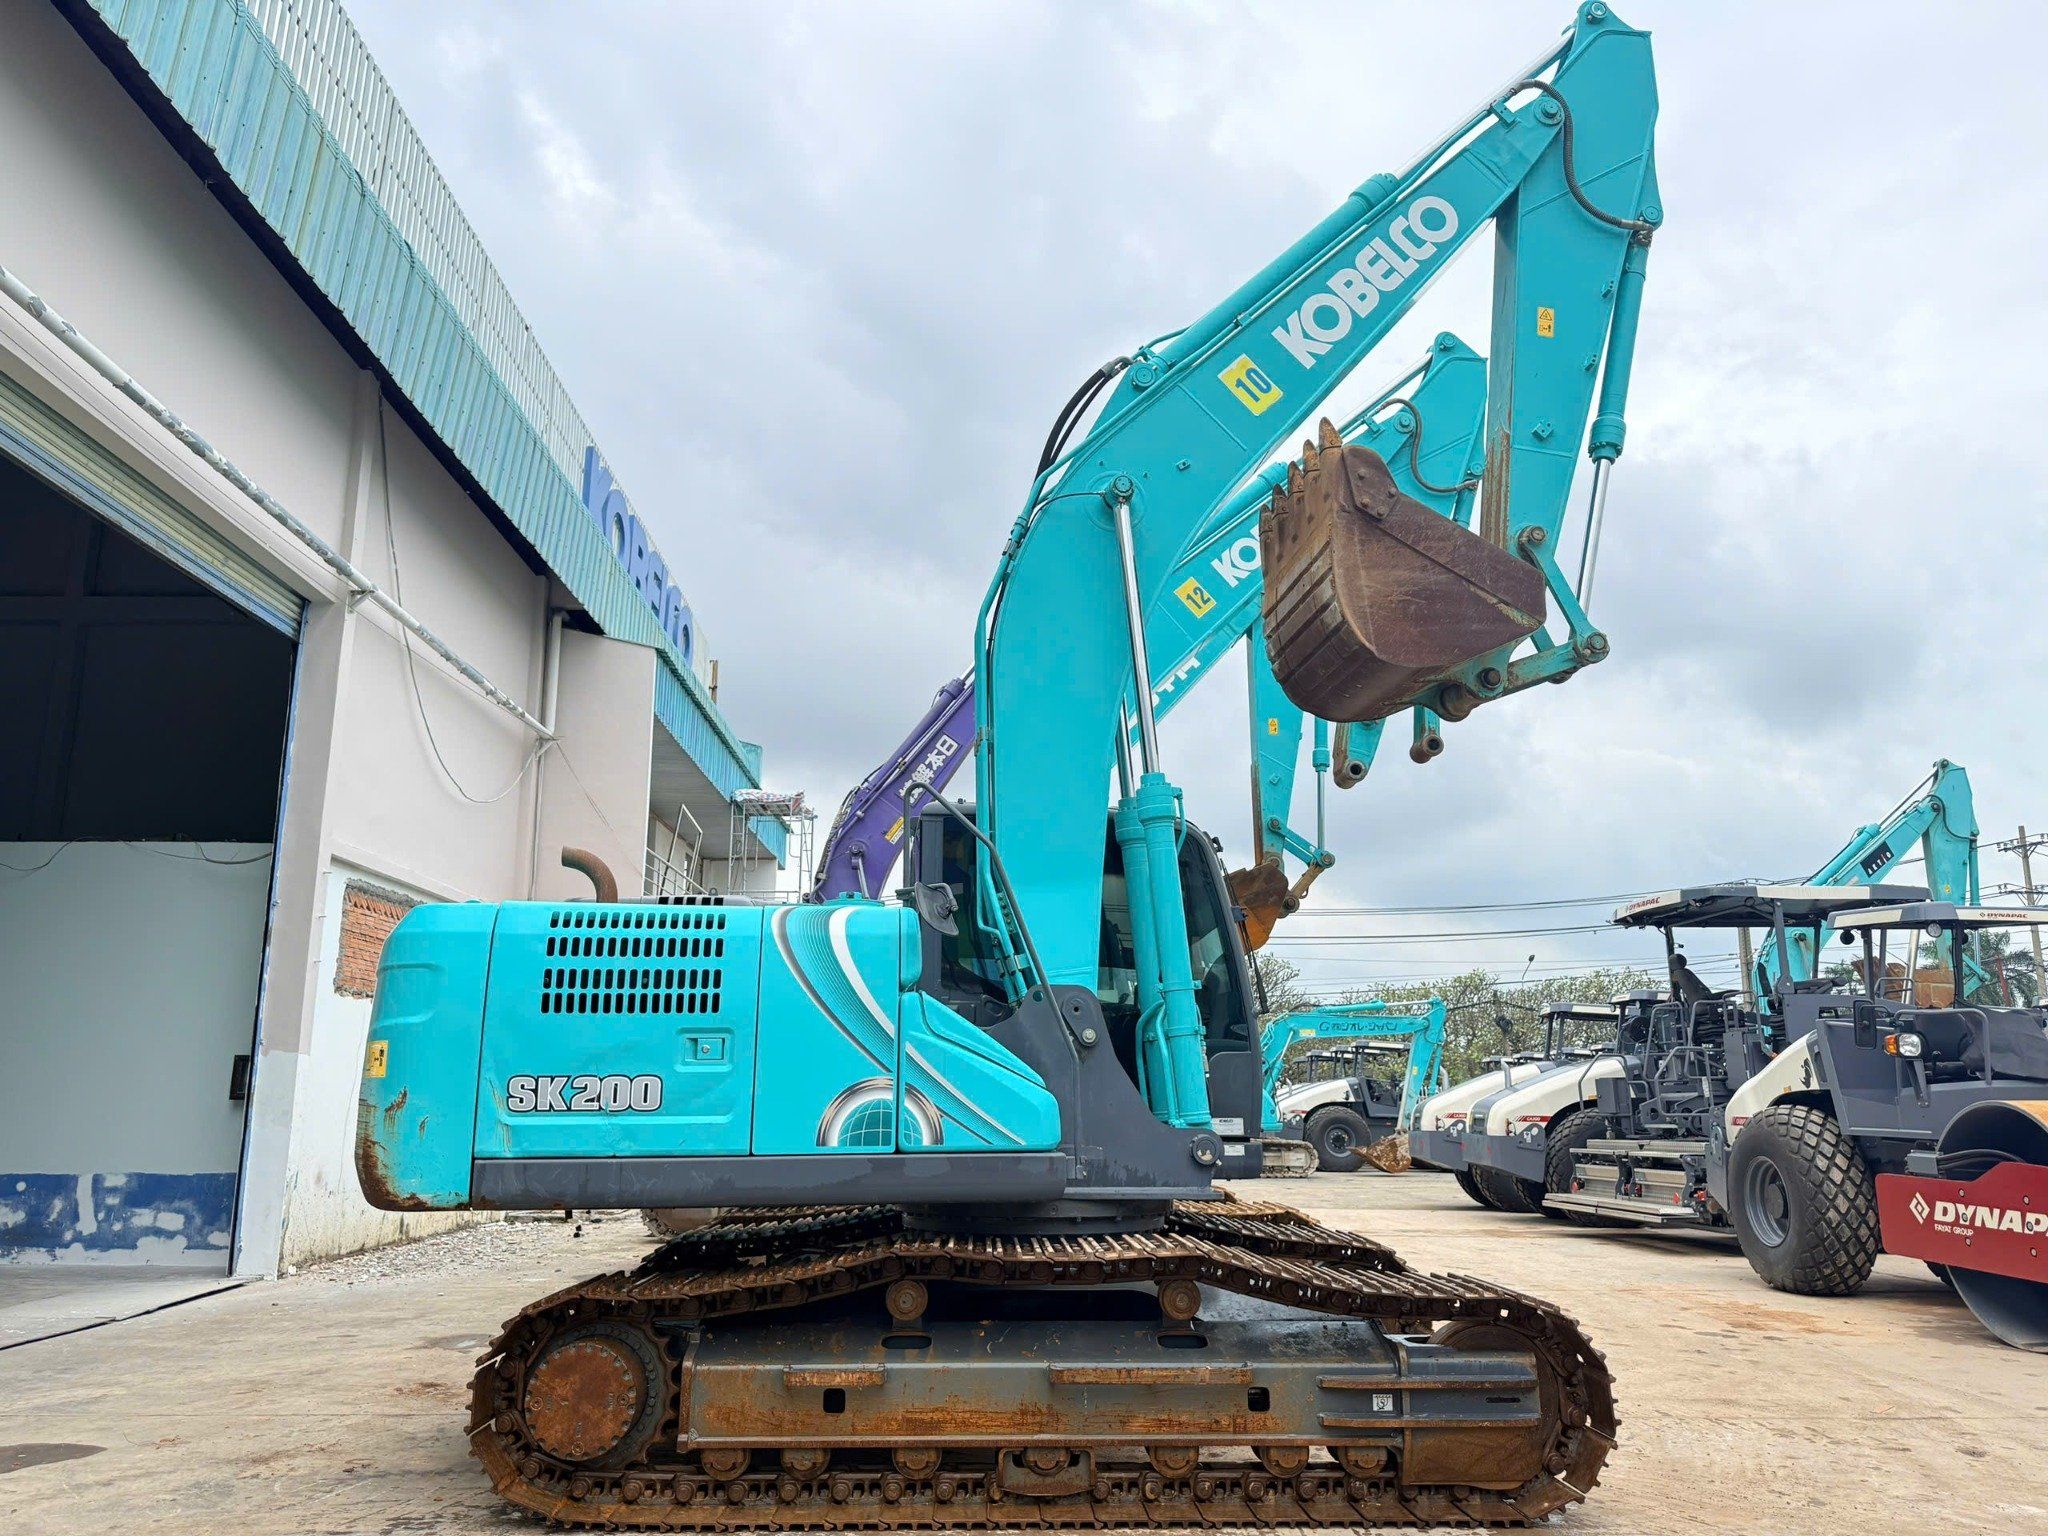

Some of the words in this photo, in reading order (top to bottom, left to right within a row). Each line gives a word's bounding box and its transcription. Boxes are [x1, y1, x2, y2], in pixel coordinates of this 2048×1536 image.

[1271, 196, 1459, 369] KOBELCO
[1235, 368, 1272, 403] 10
[1210, 524, 1262, 588] KO
[1186, 586, 1211, 609] 12
[1629, 897, 1660, 910] DYNAPAC
[507, 1074, 663, 1112] SK200
[1934, 1201, 2048, 1236] DYNAP
[1934, 1223, 1952, 1233] FAYAT
[1953, 1226, 1974, 1236] GROUP
